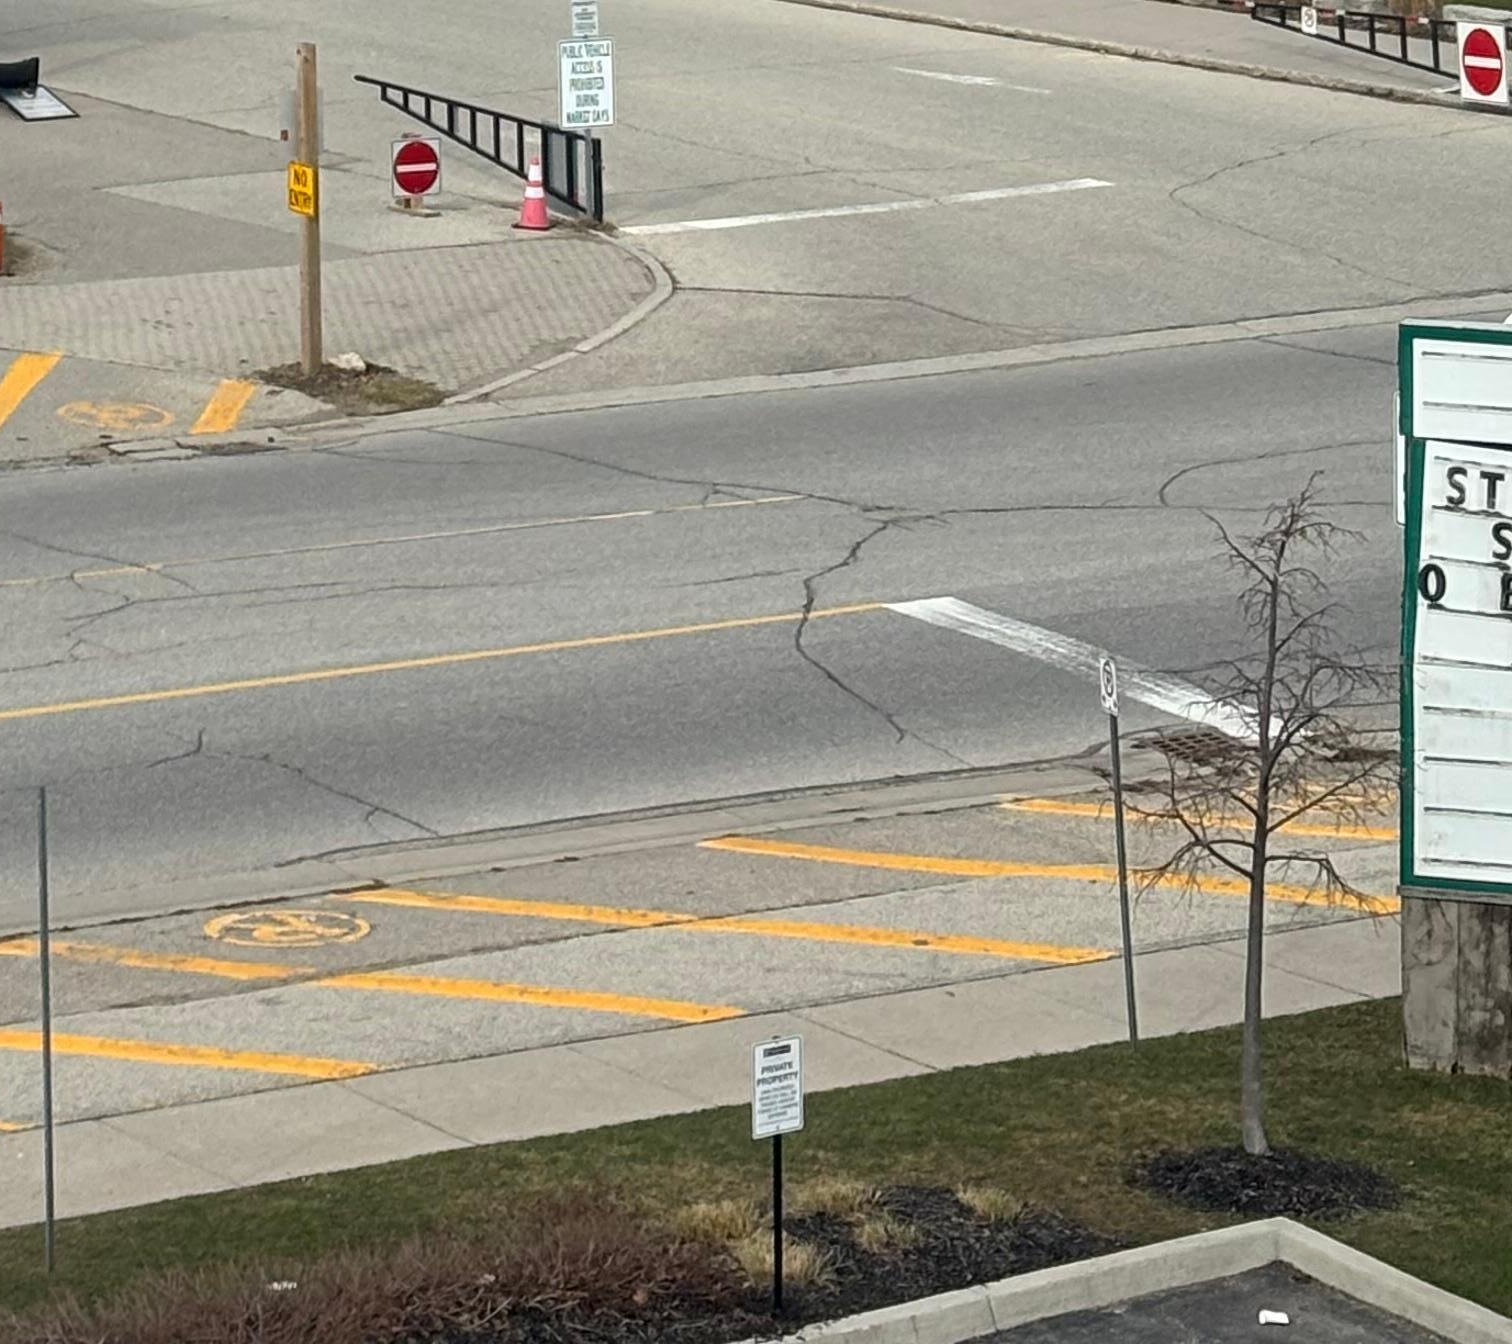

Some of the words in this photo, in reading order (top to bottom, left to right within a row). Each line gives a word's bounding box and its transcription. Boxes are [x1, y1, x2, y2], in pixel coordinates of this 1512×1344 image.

[561, 45, 584, 59] PUBLIC
[569, 77, 605, 91] PROHIBITED
[575, 94, 599, 108] DURING
[294, 169, 308, 188] NO
[288, 188, 312, 210] ENTRY
[760, 1061, 793, 1075] PRIVATE
[756, 1071, 799, 1087] PROPERTY
